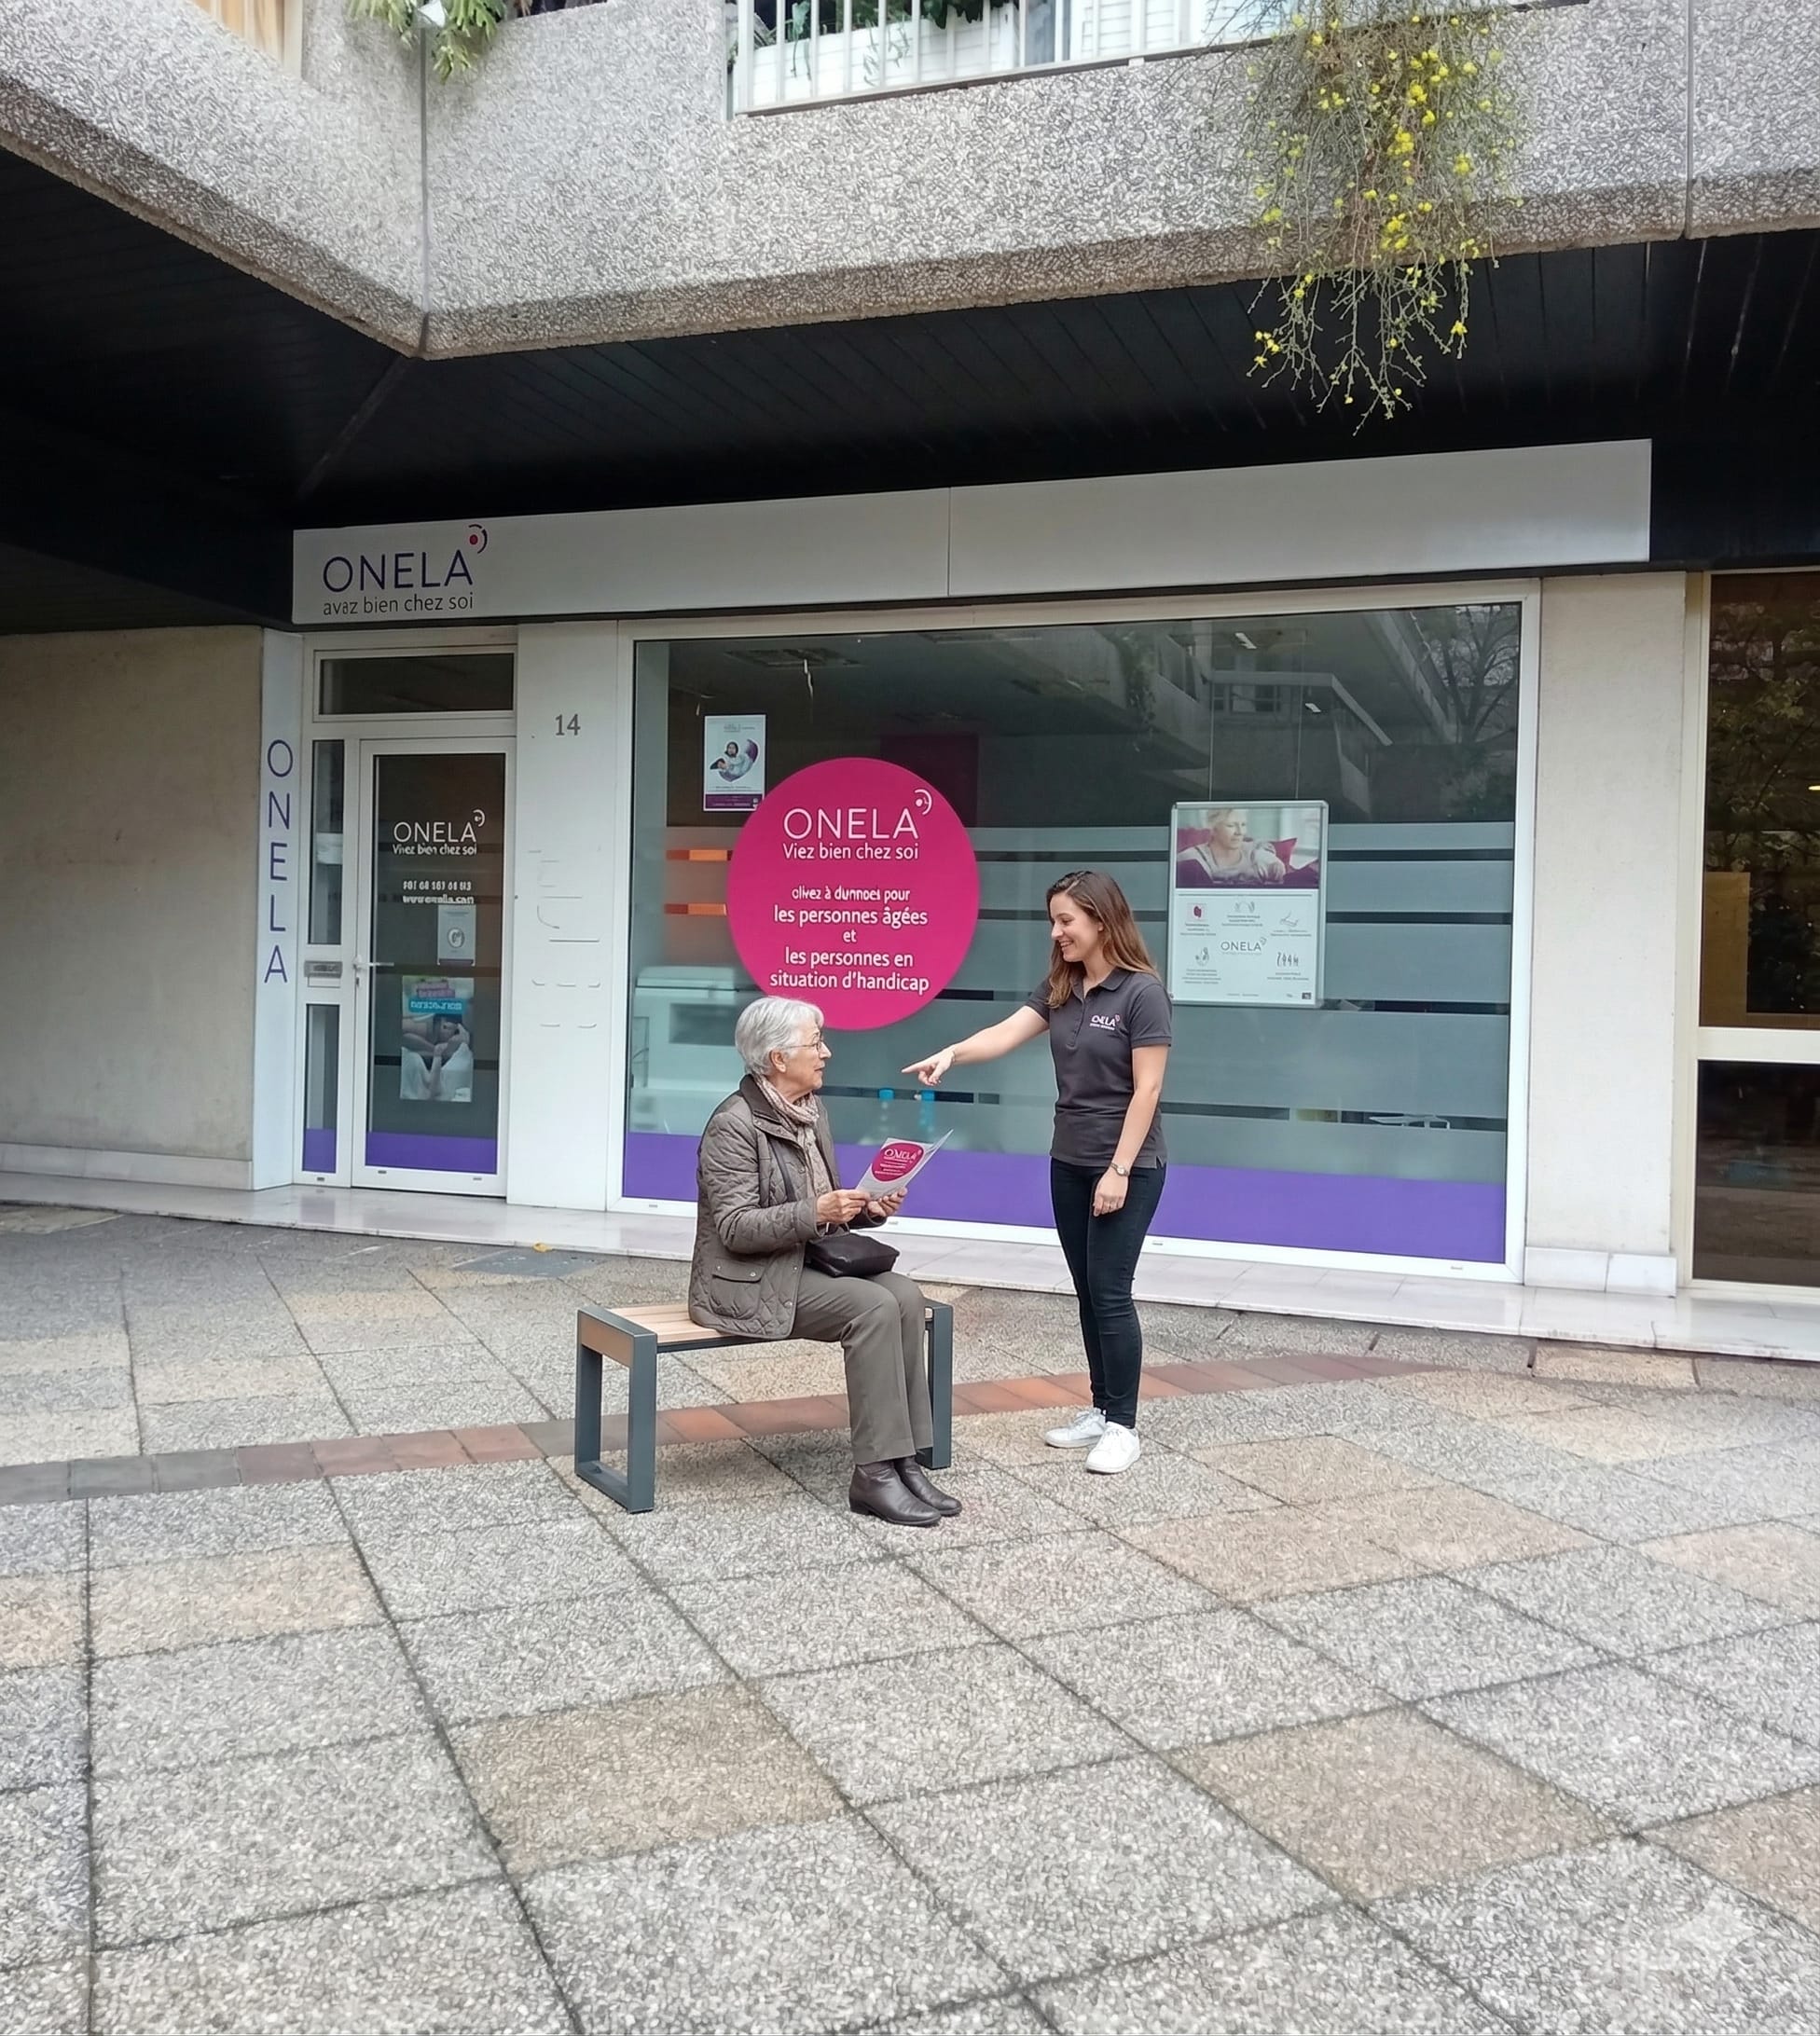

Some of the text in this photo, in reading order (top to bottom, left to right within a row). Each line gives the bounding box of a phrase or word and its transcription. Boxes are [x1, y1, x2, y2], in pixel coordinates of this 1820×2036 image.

[323, 549, 474, 593] ONELA
[364, 597, 398, 613] bien
[404, 593, 443, 612] chez
[448, 592, 473, 609] soi
[555, 713, 581, 736] 14
[393, 821, 476, 842] ONELA
[783, 808, 918, 839] ONELA
[462, 843, 476, 855] soi
[782, 842, 918, 860] Viez bien chez soi
[264, 739, 293, 984] ONELA
[824, 885, 832, 900] à
[884, 888, 911, 904] pour
[774, 904, 929, 929] les personnes âgées
[843, 929, 857, 942] et
[1220, 941, 1262, 952] ONELA
[785, 946, 913, 969] les personnes en
[769, 970, 930, 996] situation d'handicap
